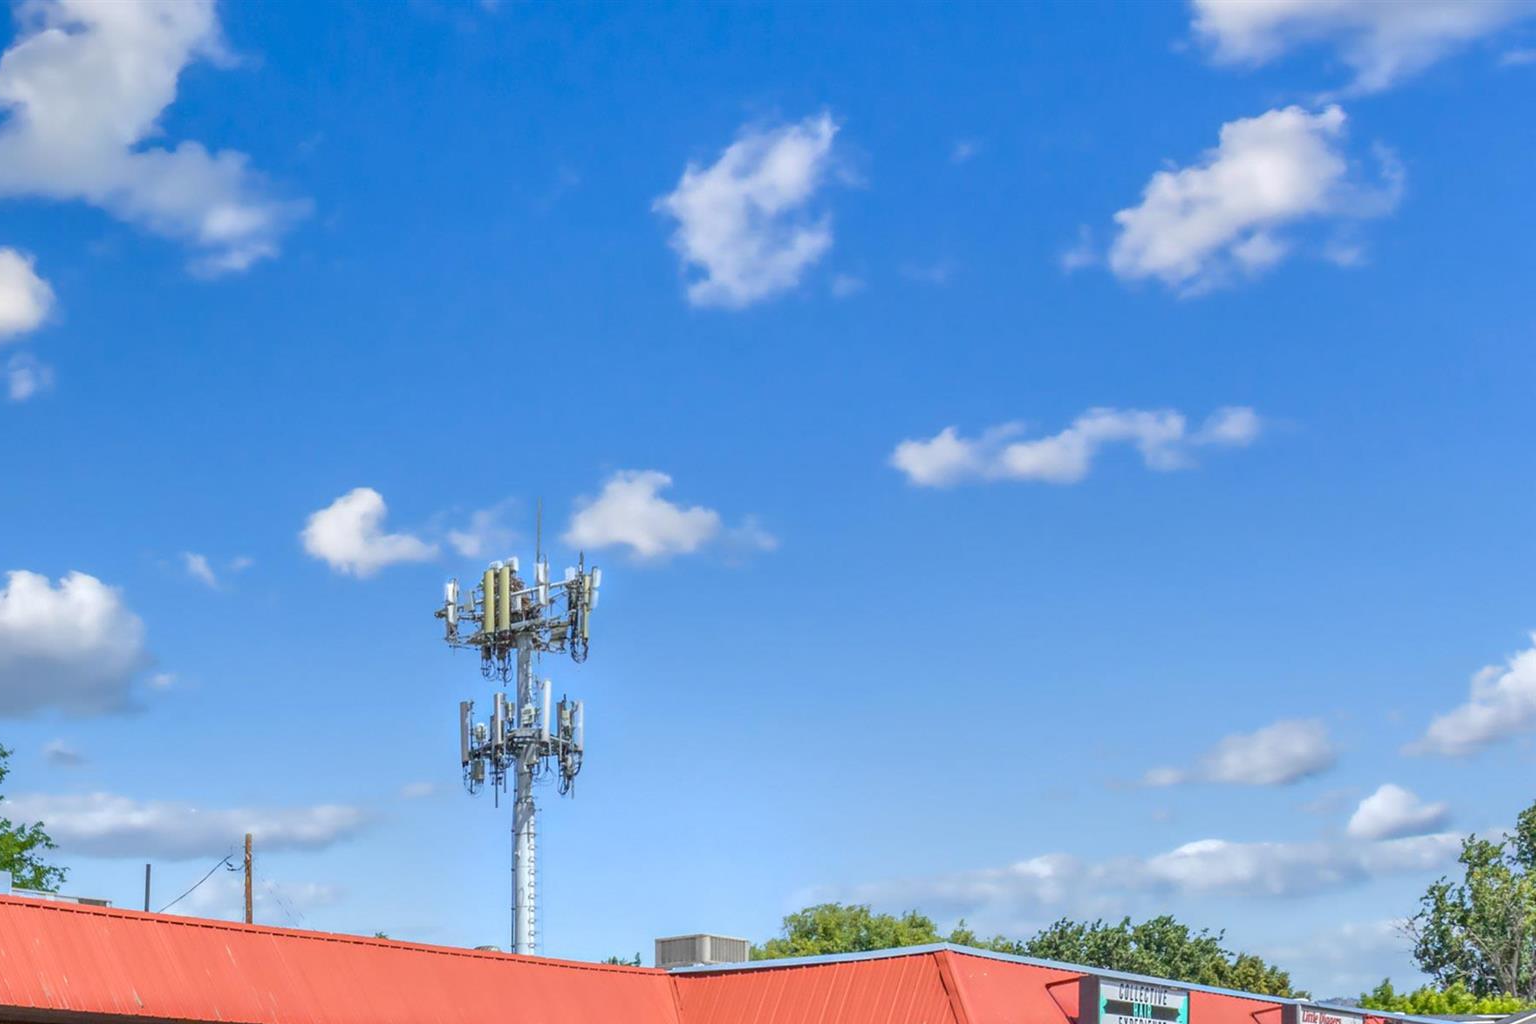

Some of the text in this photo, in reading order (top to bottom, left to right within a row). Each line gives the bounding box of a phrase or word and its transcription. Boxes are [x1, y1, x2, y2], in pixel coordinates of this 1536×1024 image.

[1118, 983, 1168, 1006] COLLECTIVE
[1133, 1003, 1152, 1019] HAIR
[1303, 1010, 1318, 1024] Little
